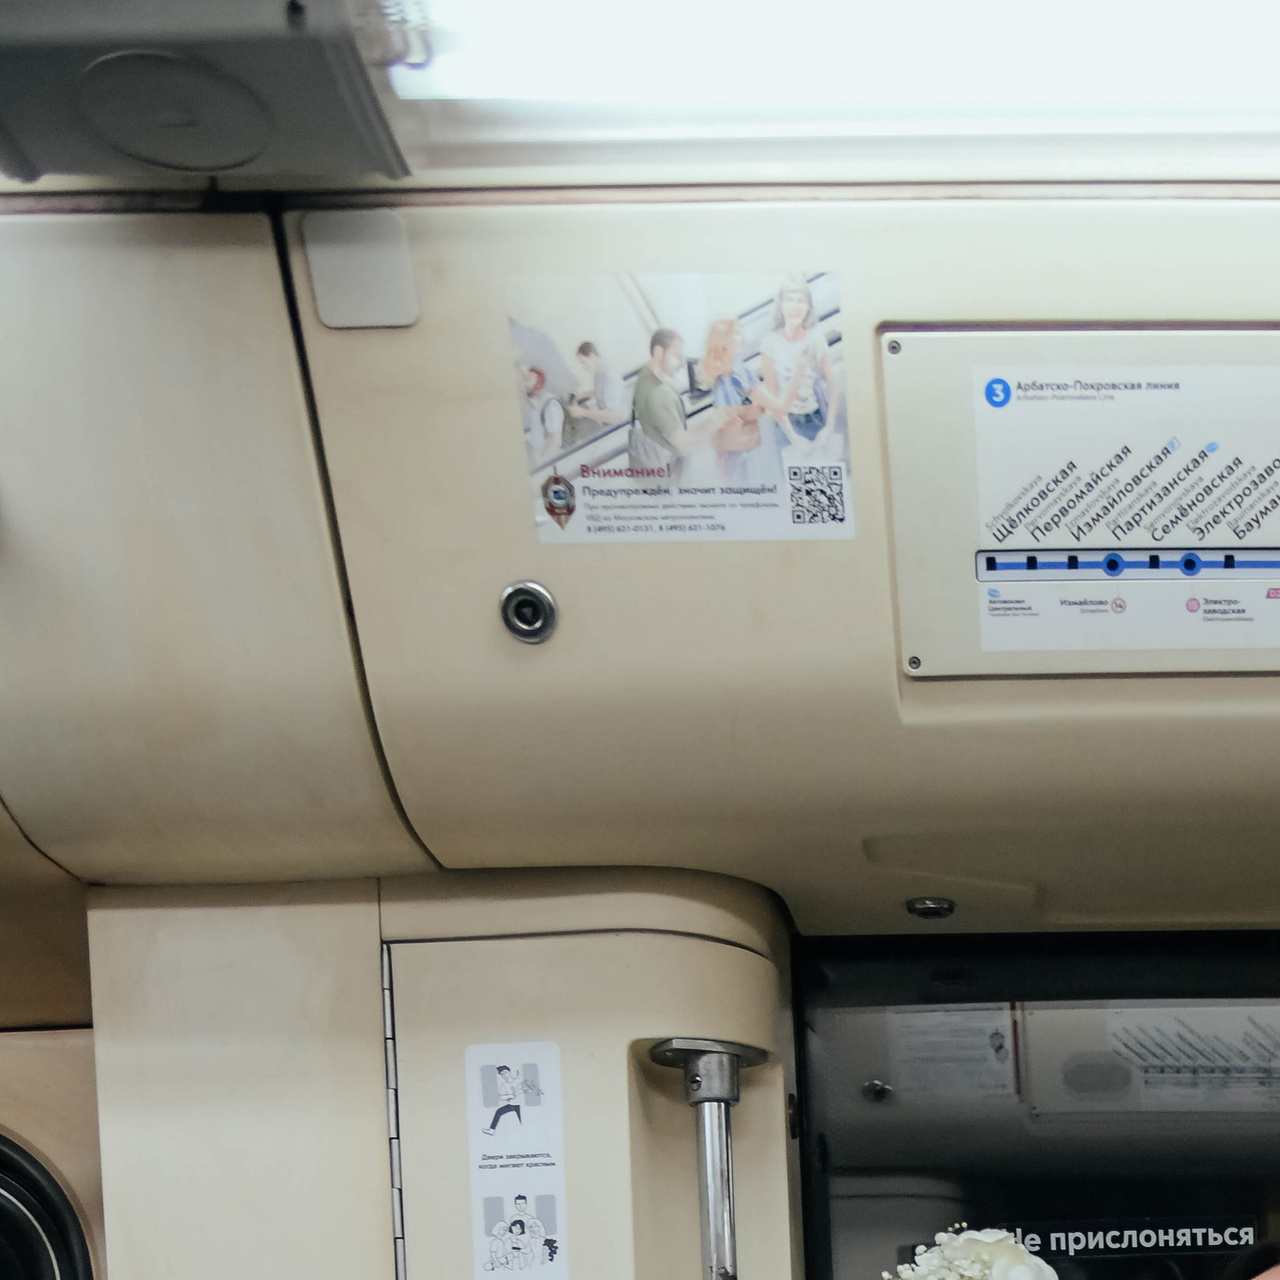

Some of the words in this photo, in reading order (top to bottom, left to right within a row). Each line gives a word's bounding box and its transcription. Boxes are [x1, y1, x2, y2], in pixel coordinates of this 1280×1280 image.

[1016, 381, 1142, 393] Арбатско-Покровская
[580, 463, 671, 478] Внимание!
[992, 461, 1078, 543] Щёлковская
[1031, 445, 1132, 542] Первомайская
[1070, 446, 1172, 542] Измайловская
[1111, 449, 1209, 541] Партизанская
[1151, 456, 1243, 542] Семёновская
[1051, 1226, 1255, 1256] прислоняться
